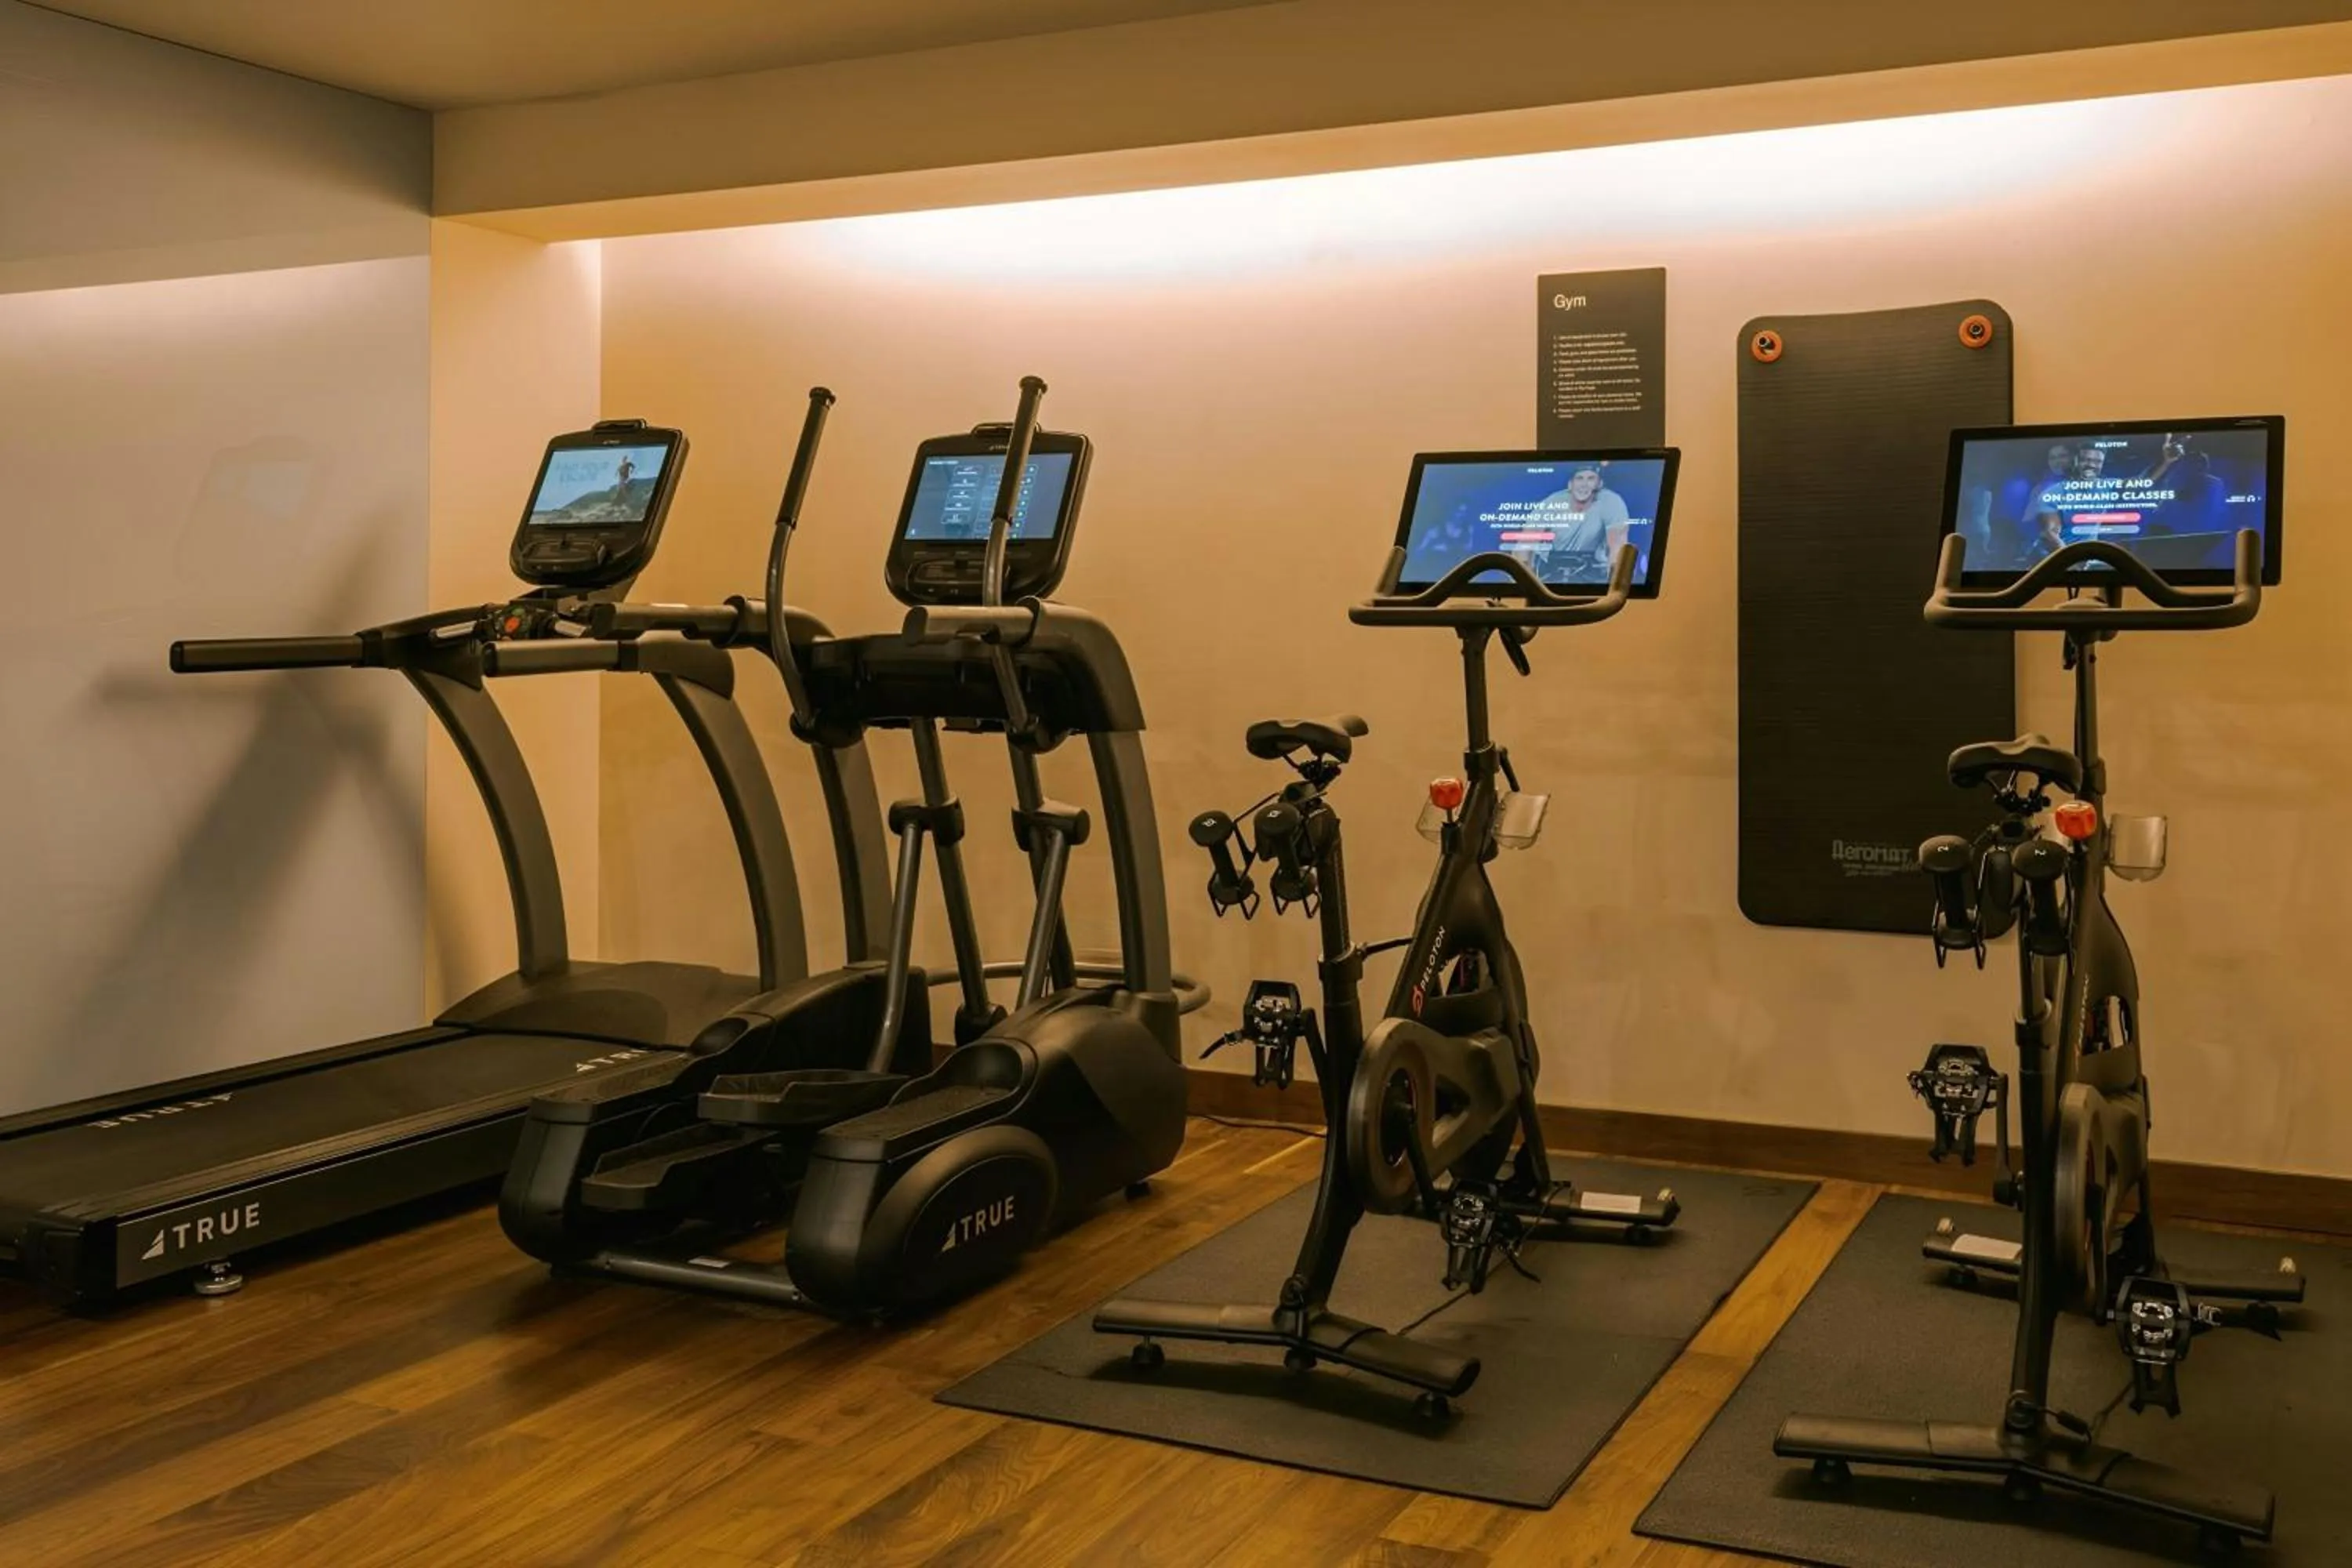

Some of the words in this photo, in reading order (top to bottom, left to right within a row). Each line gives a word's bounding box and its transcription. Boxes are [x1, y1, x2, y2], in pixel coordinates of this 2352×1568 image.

[1553, 294, 1586, 310] Gym
[2063, 481, 2093, 490] JOIN
[2096, 480, 2122, 489] LIVE
[2125, 478, 2154, 488] AND
[2042, 492, 2119, 503] ON-DEMAND
[2122, 490, 2175, 500] CLASSES
[1498, 502, 1522, 510] JOIN
[1523, 502, 1544, 510] LIVE
[1547, 502, 1569, 510] AND
[1479, 513, 1541, 521] ON-DEMAND
[1421, 925, 1446, 992] PELOTON
[960, 1195, 1014, 1241] TRUE
[172, 1202, 260, 1250] TRUE
